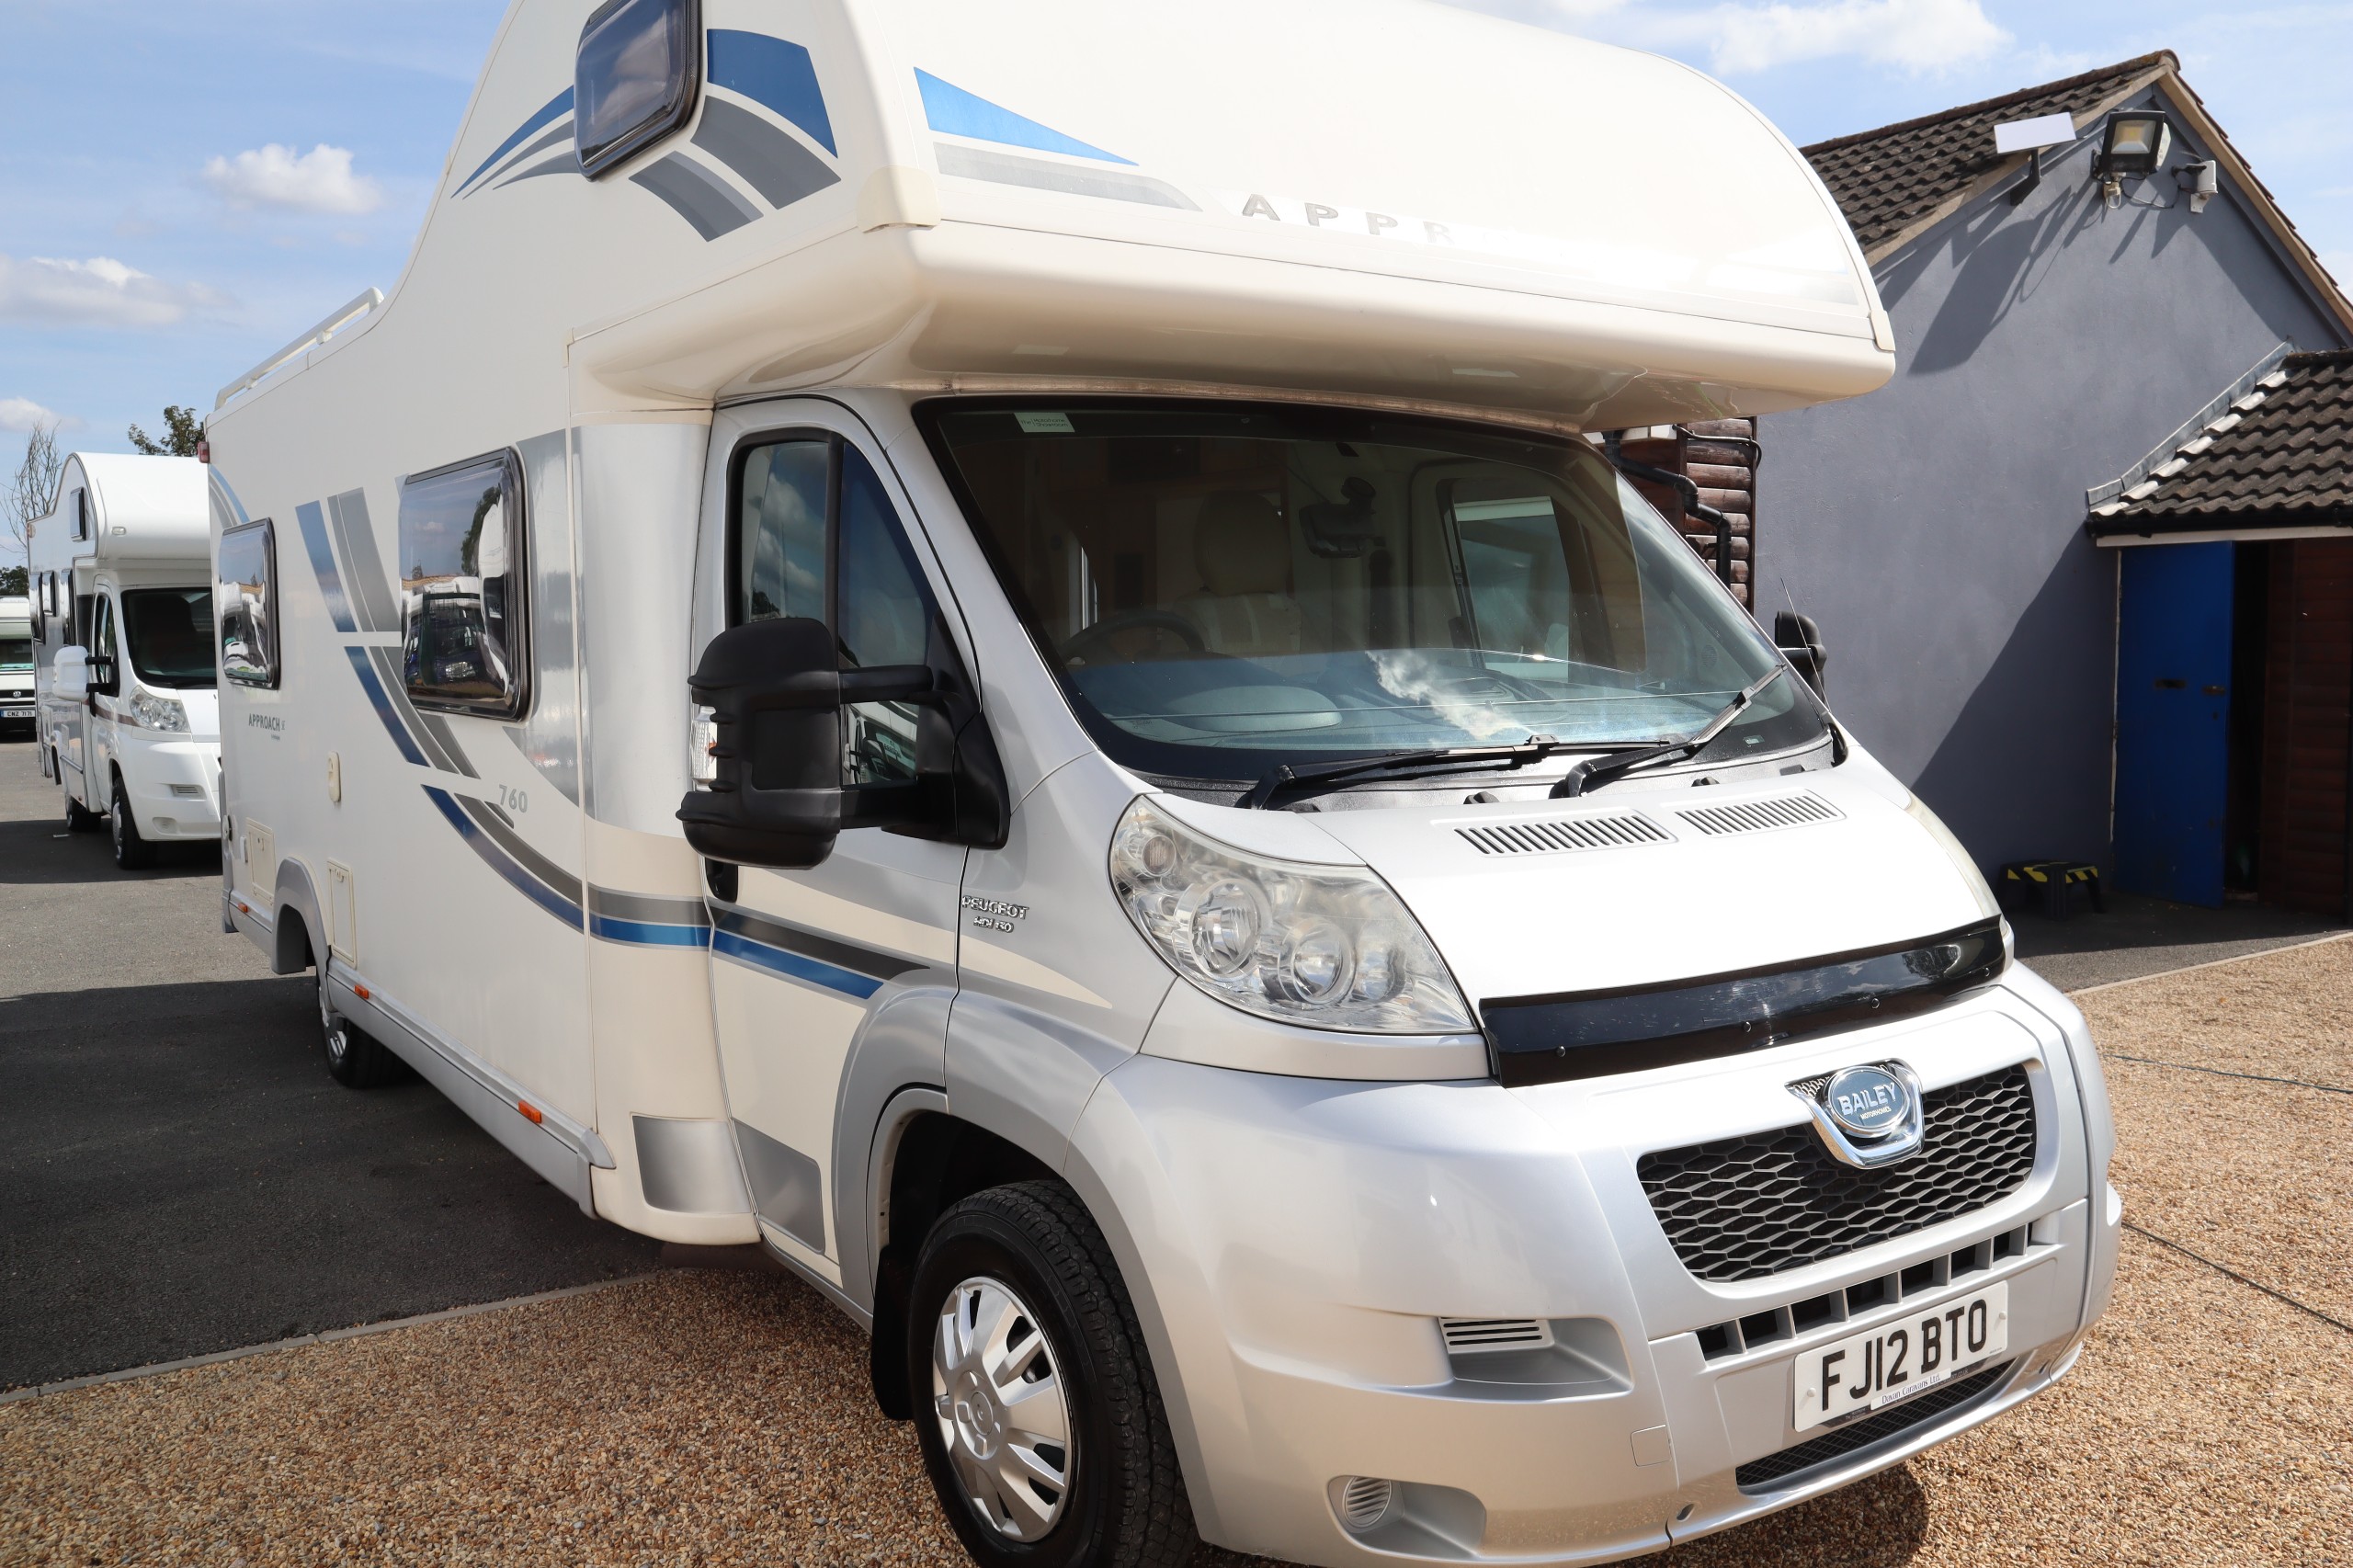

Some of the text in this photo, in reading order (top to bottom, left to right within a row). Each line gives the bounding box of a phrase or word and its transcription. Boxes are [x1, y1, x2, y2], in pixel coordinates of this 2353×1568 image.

[248, 712, 280, 733] APPROACH
[498, 783, 529, 813] 760
[961, 895, 1029, 920] PEUGEOT
[1837, 1082, 1896, 1116] BAILEY
[1860, 1106, 1892, 1120] MOTORHOMES
[1822, 1299, 1987, 1411] FJ12 BTO
[1881, 1390, 1901, 1404] Davan
[1902, 1380, 1928, 1396] Caravans
[1929, 1372, 1941, 1384] Ltd.
